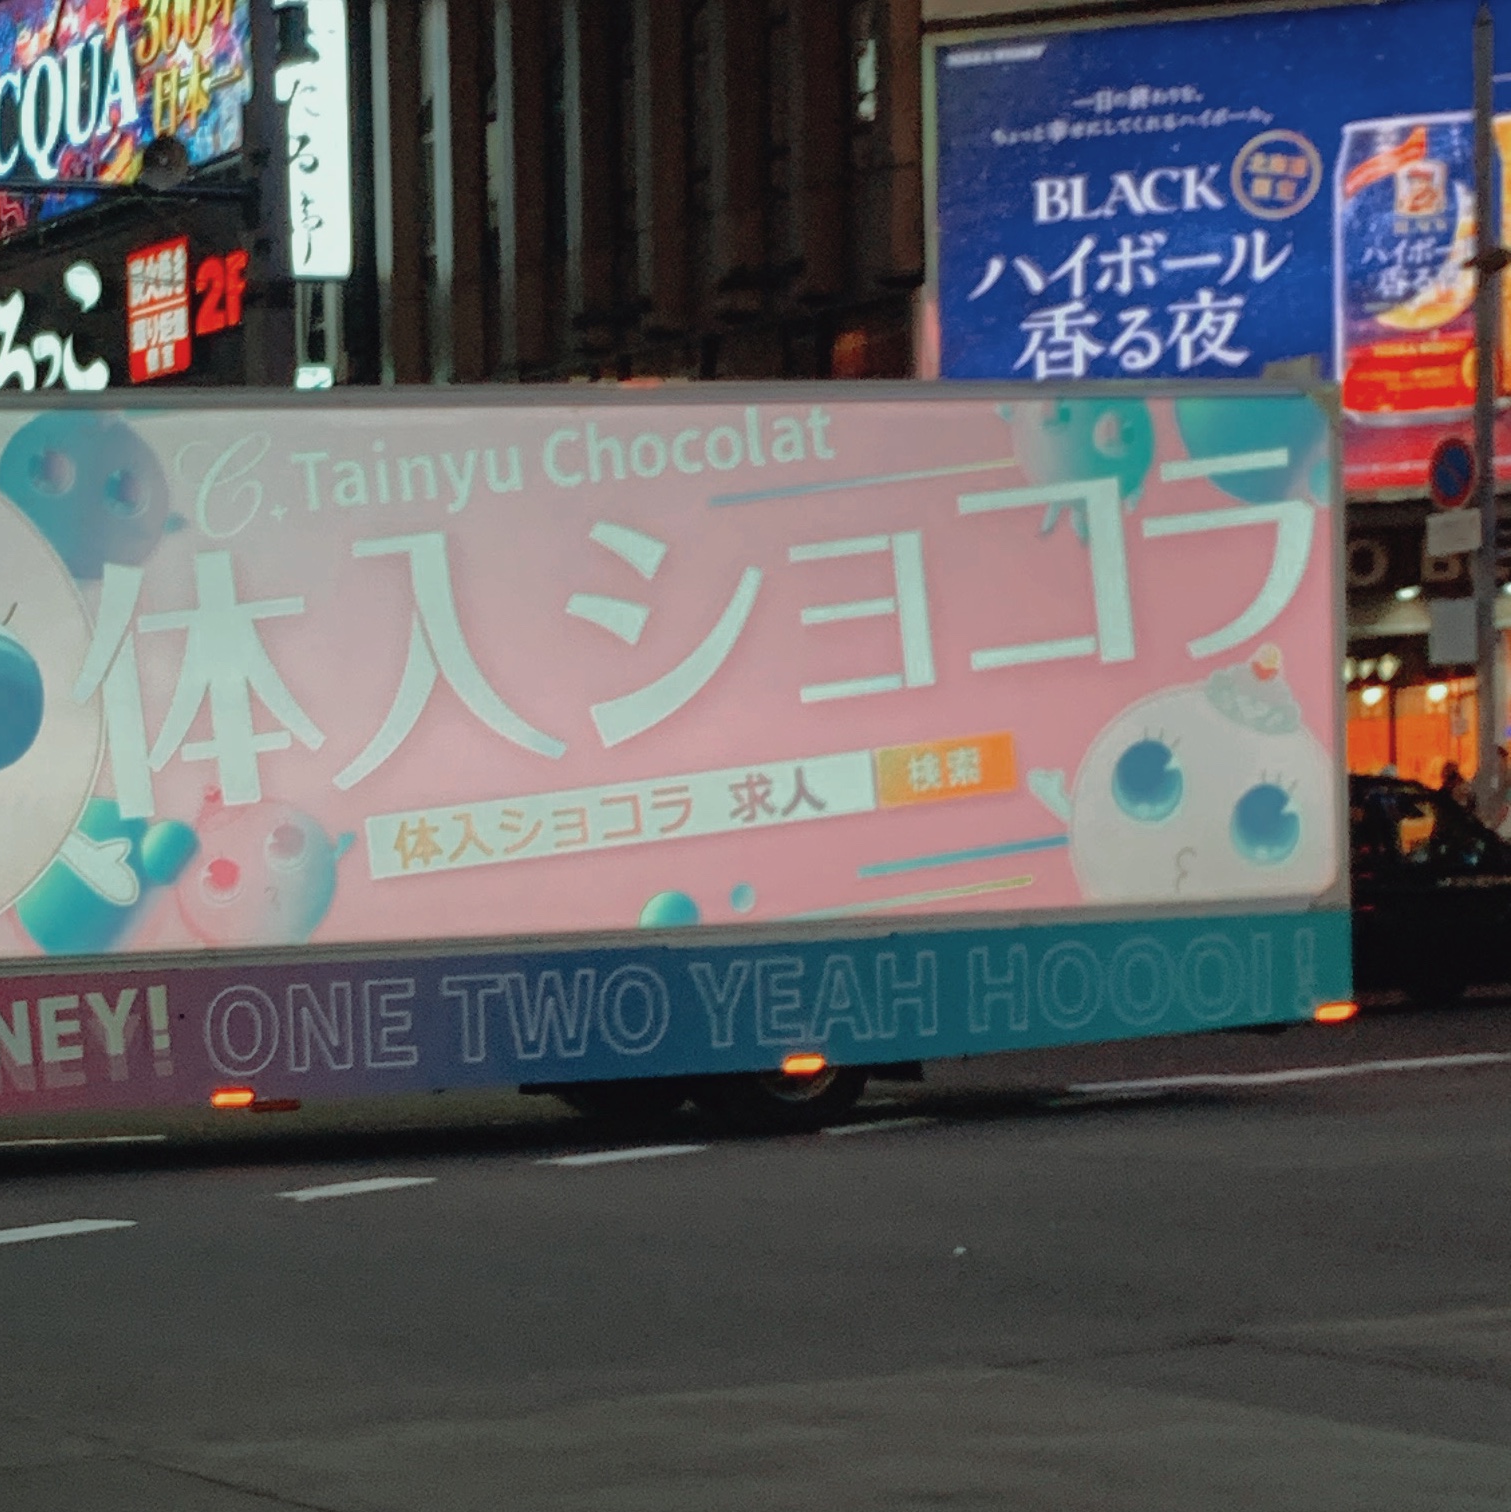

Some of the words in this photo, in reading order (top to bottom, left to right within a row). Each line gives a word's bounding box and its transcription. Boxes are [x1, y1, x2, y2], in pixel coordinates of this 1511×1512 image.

[1034, 164, 1225, 225] BLACK
[195, 248, 250, 336] 2F
[968, 229, 1293, 301] ハイボール
[1013, 290, 1250, 381] 香る夜
[291, 438, 524, 514] Tainyu
[543, 406, 837, 485] Chocolat
[73, 448, 1316, 820] 体入ショコラ
[392, 785, 694, 870] 体入ショコラ
[727, 767, 827, 824] 求人
[906, 746, 982, 793] 検索
[203, 977, 419, 1077] ONE
[440, 964, 671, 1065] TWO
[690, 949, 938, 1049] YEAH
